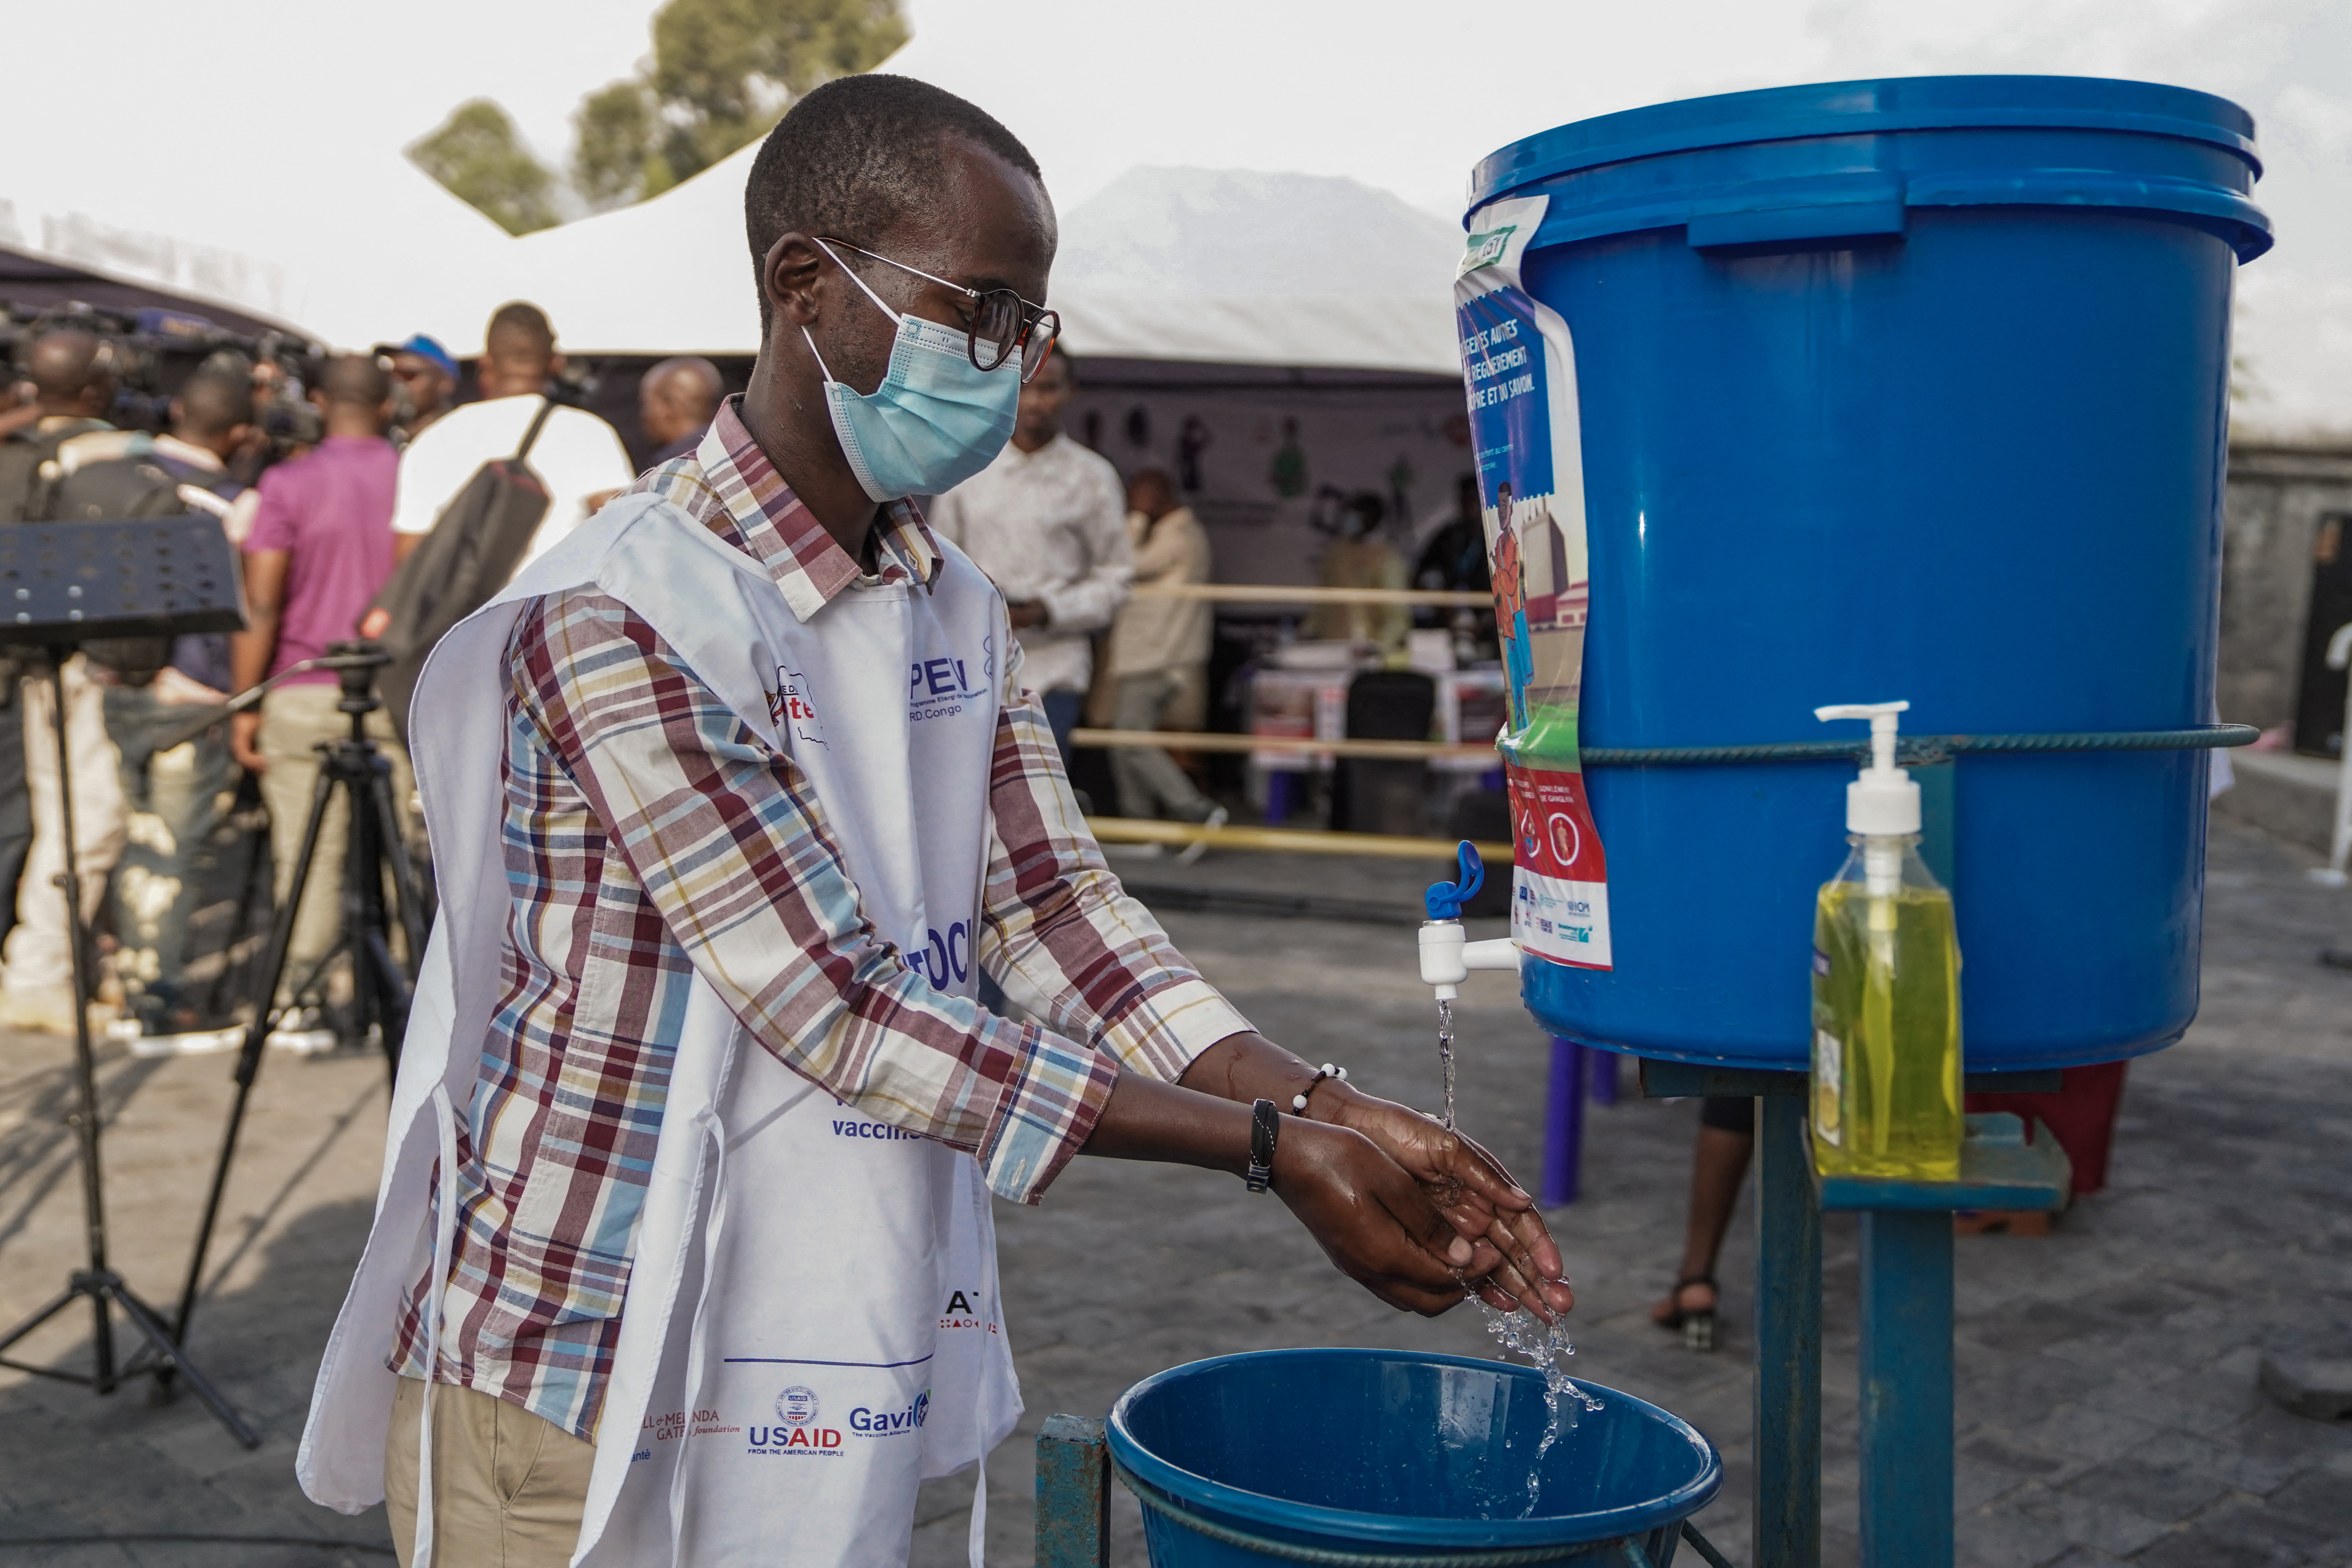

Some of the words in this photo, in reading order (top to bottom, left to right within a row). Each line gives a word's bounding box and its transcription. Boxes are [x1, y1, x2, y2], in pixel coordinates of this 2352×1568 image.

[1487, 386, 1497, 405] ET
[910, 658, 967, 699] PEV
[910, 699, 936, 708] Programme
[910, 705, 961, 722] RD.Congo
[850, 1405, 913, 1431] Gavi
[657, 1425, 691, 1440] GATE
[693, 1424, 740, 1436] foundation
[750, 1427, 841, 1448] USAID
[631, 1448, 651, 1462] anté
